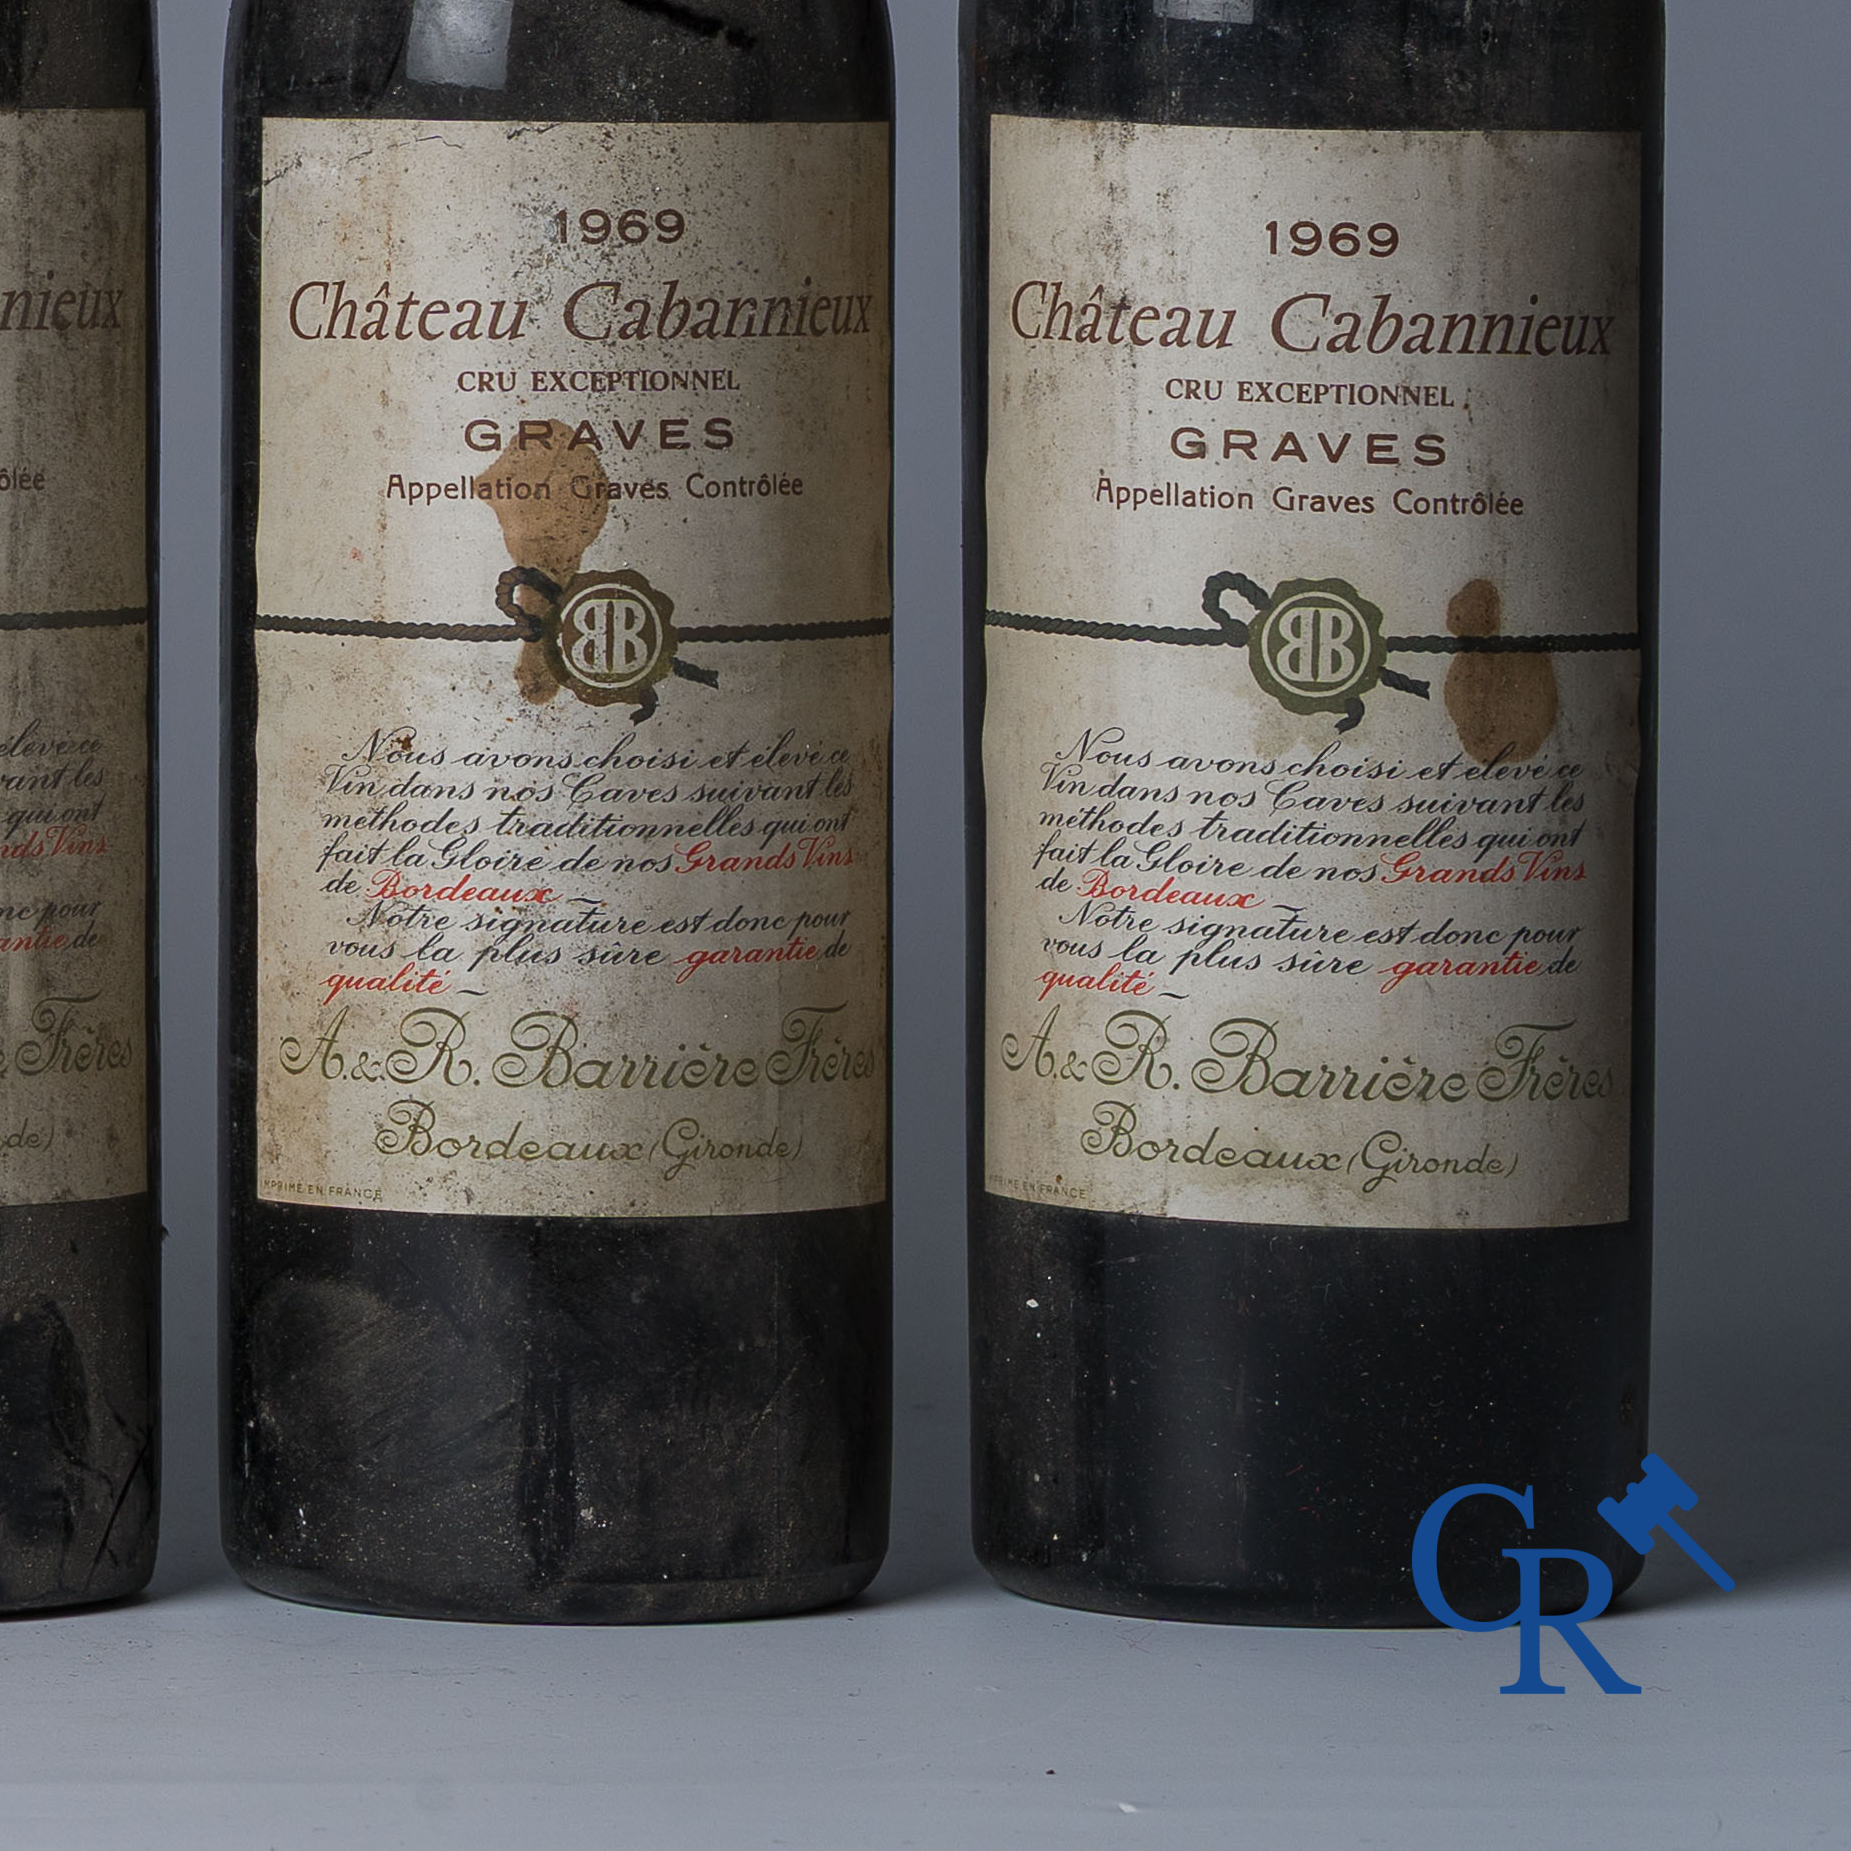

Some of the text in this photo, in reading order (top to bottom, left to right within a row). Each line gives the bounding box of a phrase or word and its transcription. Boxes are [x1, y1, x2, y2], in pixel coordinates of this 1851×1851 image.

[555, 208, 686, 245] 1969
[1265, 221, 1399, 258] 1969
[291, 275, 875, 343] Château Cabannieux
[1011, 280, 1614, 359] Château Cabannieux
[458, 369, 741, 392] CRU EXCEPTIONNEL
[1166, 378, 1454, 405] CRU EXCEPTIONNEL
[465, 417, 735, 453] GRAVES
[1171, 427, 1446, 465] GRAVES
[388, 472, 804, 504] Appellation Graves Contrôlée
[1097, 477, 1524, 517] Appellation Graves Contrôlée
[376, 1098, 646, 1162] Bordeaux
[1080, 1100, 1341, 1171] Bordeaux
